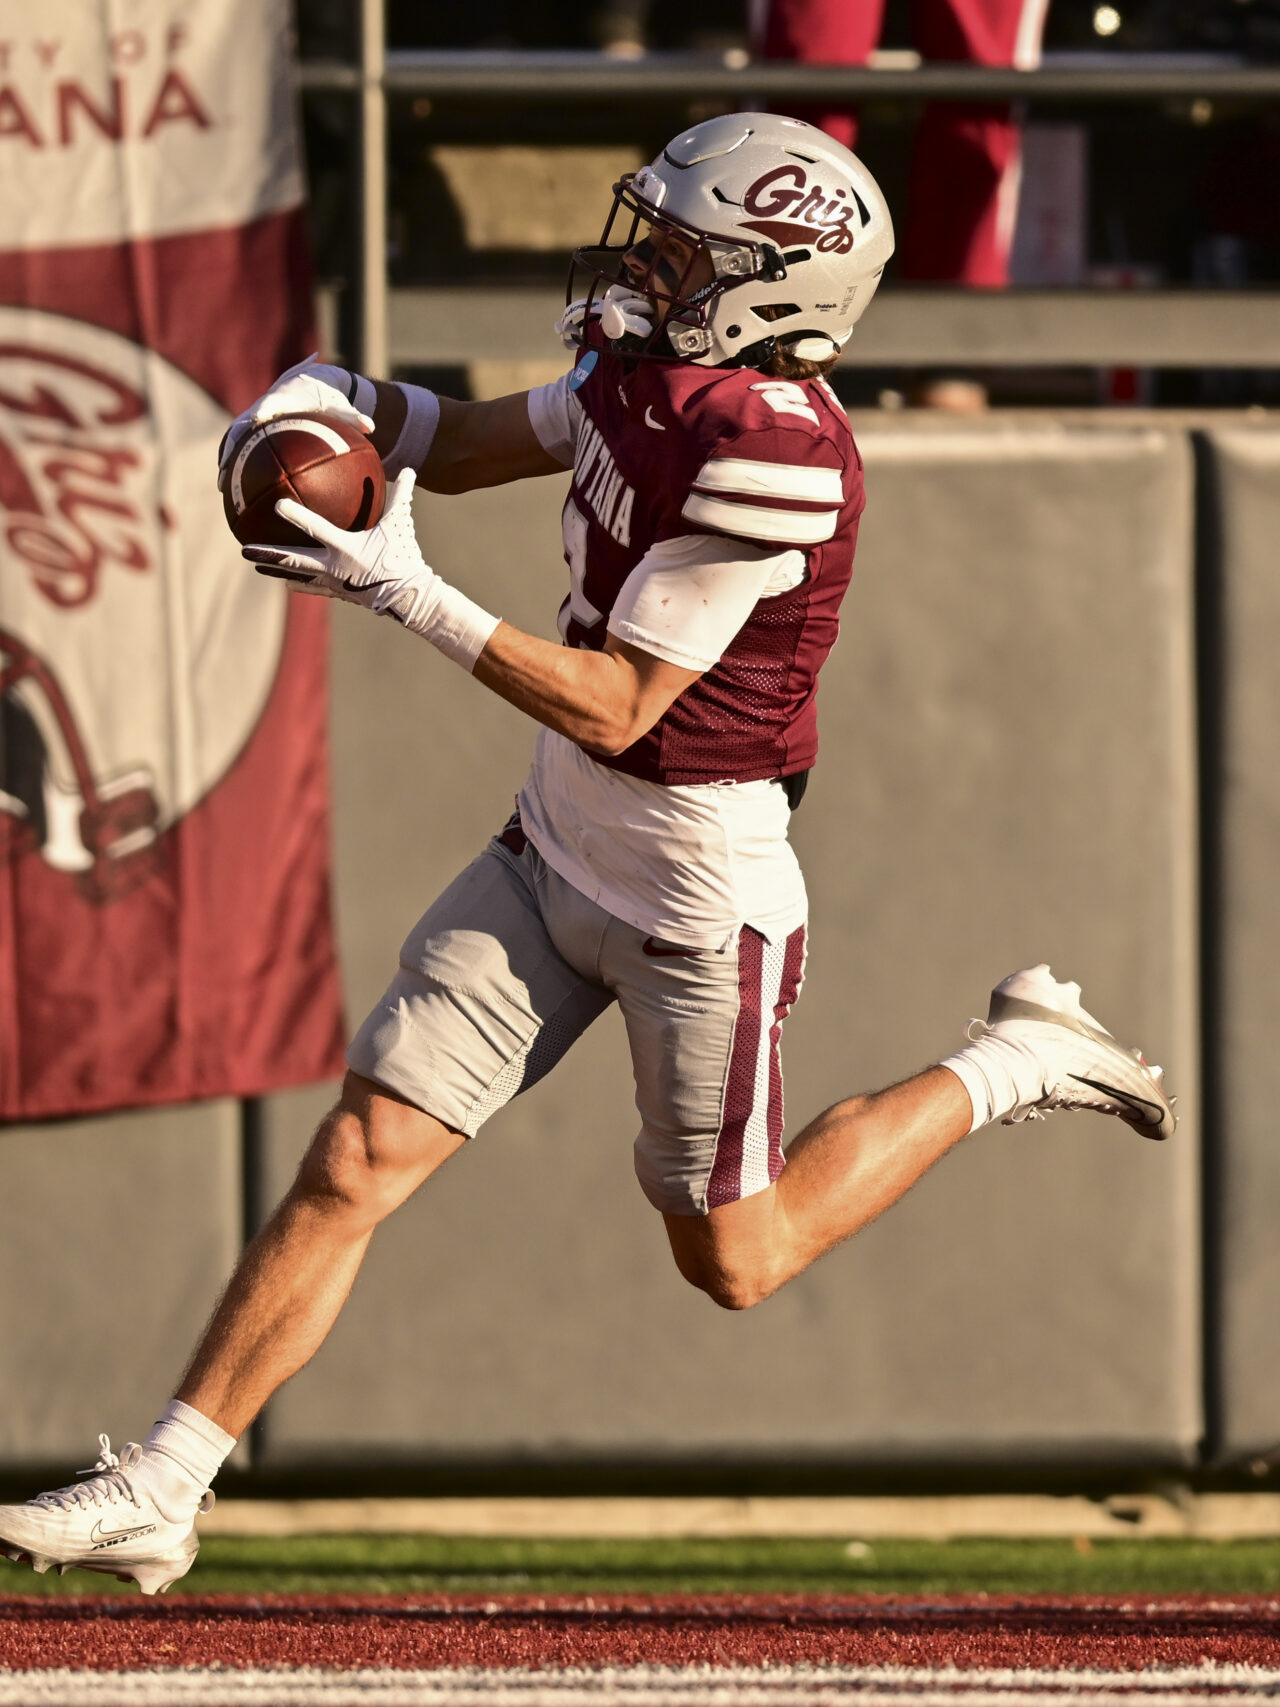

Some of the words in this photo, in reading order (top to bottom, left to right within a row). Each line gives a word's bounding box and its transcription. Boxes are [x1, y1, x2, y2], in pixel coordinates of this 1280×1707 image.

[111, 23, 187, 66] OF
[744, 165, 854, 255] Griz
[747, 381, 821, 428] 2
[129, 1526, 157, 1540] ZOOM
